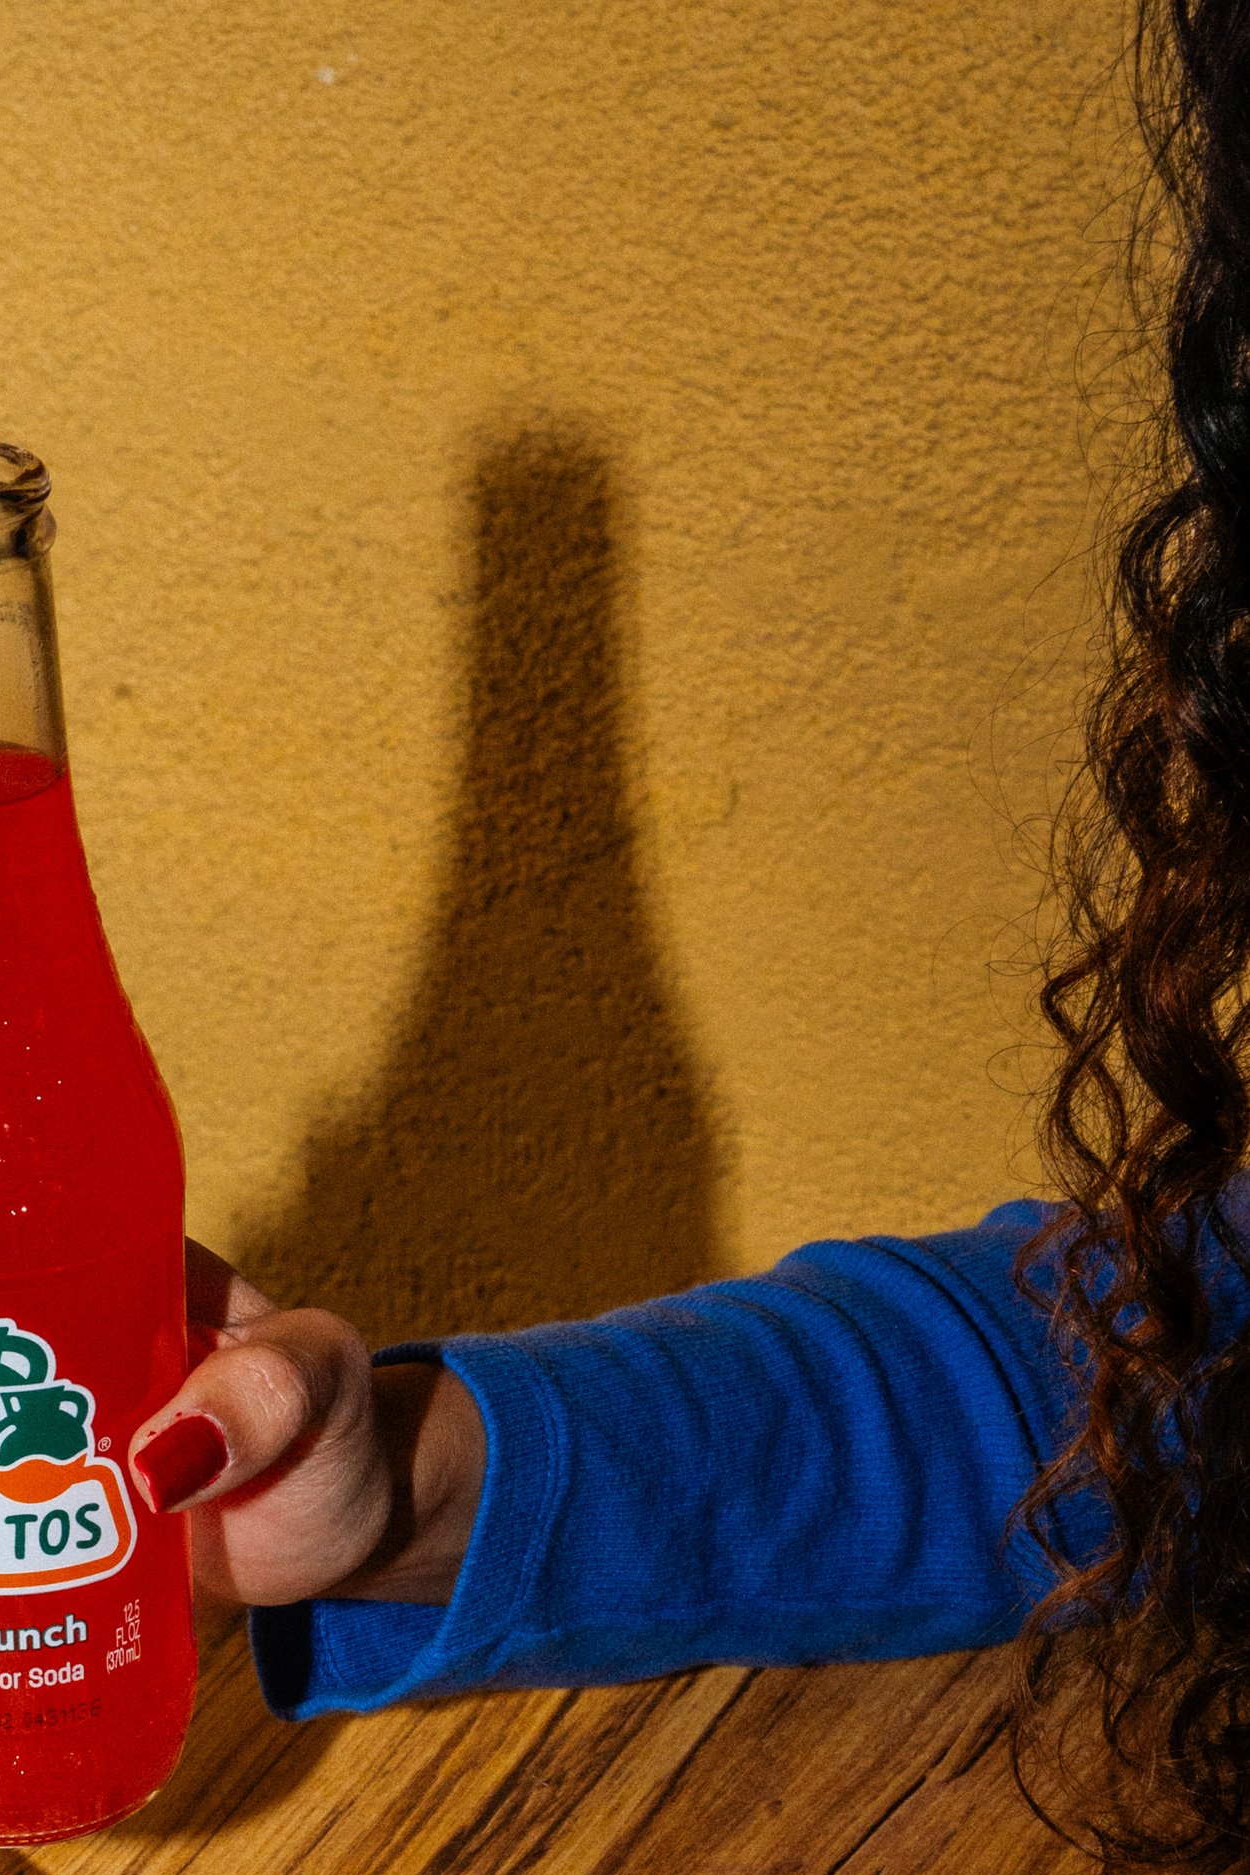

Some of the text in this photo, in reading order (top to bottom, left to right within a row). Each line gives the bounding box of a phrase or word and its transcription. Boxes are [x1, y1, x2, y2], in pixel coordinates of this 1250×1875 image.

[123, 1598, 140, 1623] 12.5
[115, 1618, 141, 1648] FL OZ
[29, 1660, 85, 1689] Soda
[106, 1647, 125, 1675] (370
